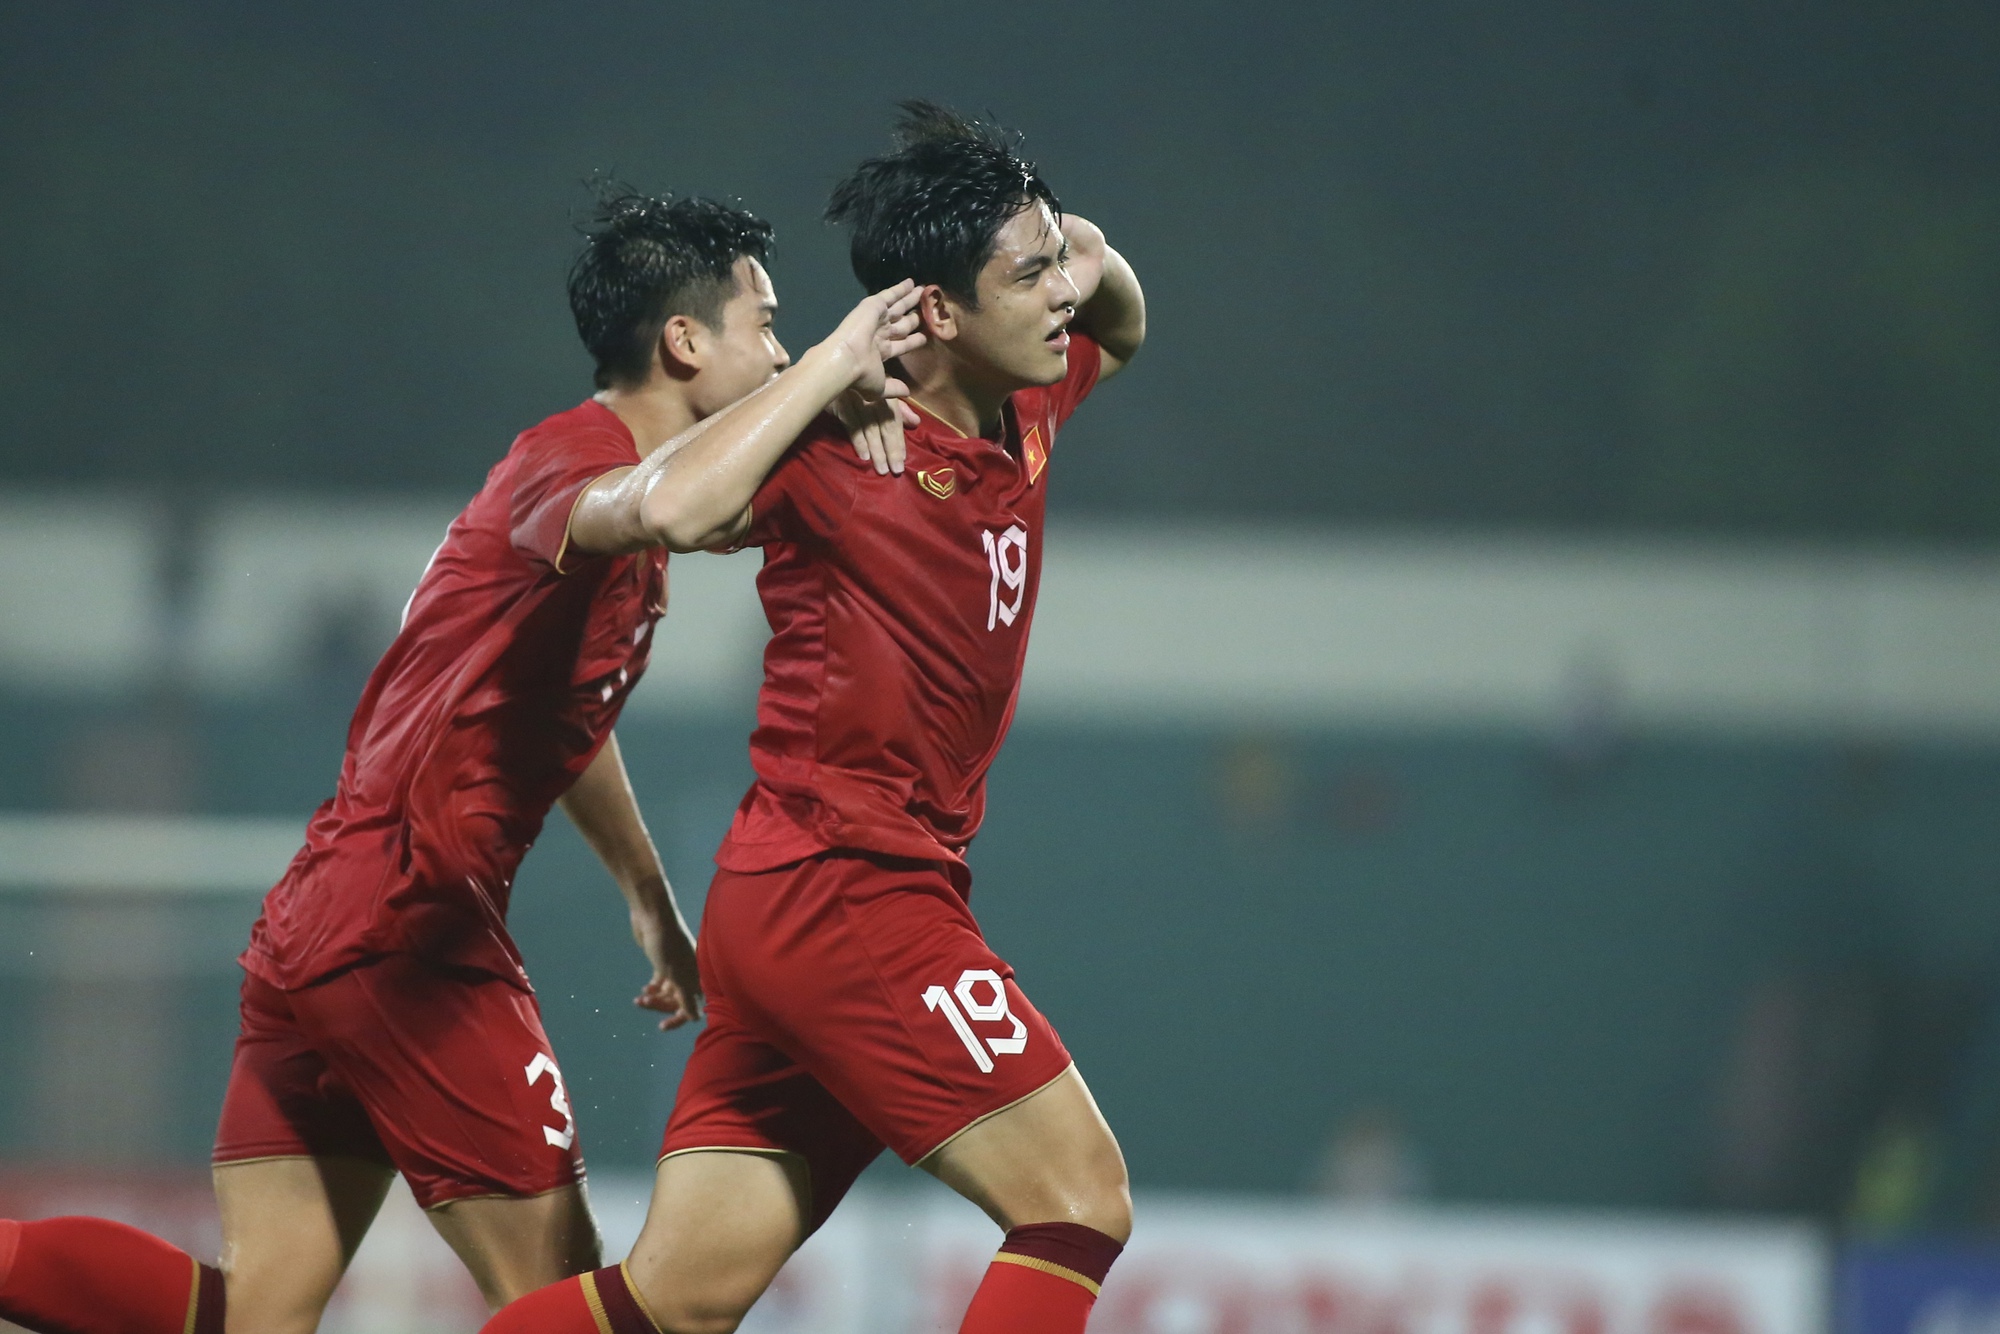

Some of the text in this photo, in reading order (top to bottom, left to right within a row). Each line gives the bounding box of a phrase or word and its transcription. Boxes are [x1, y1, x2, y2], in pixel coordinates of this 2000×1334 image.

[981, 524, 1027, 632] 19
[920, 969, 1028, 1073] 19
[524, 1051, 574, 1151] 3
